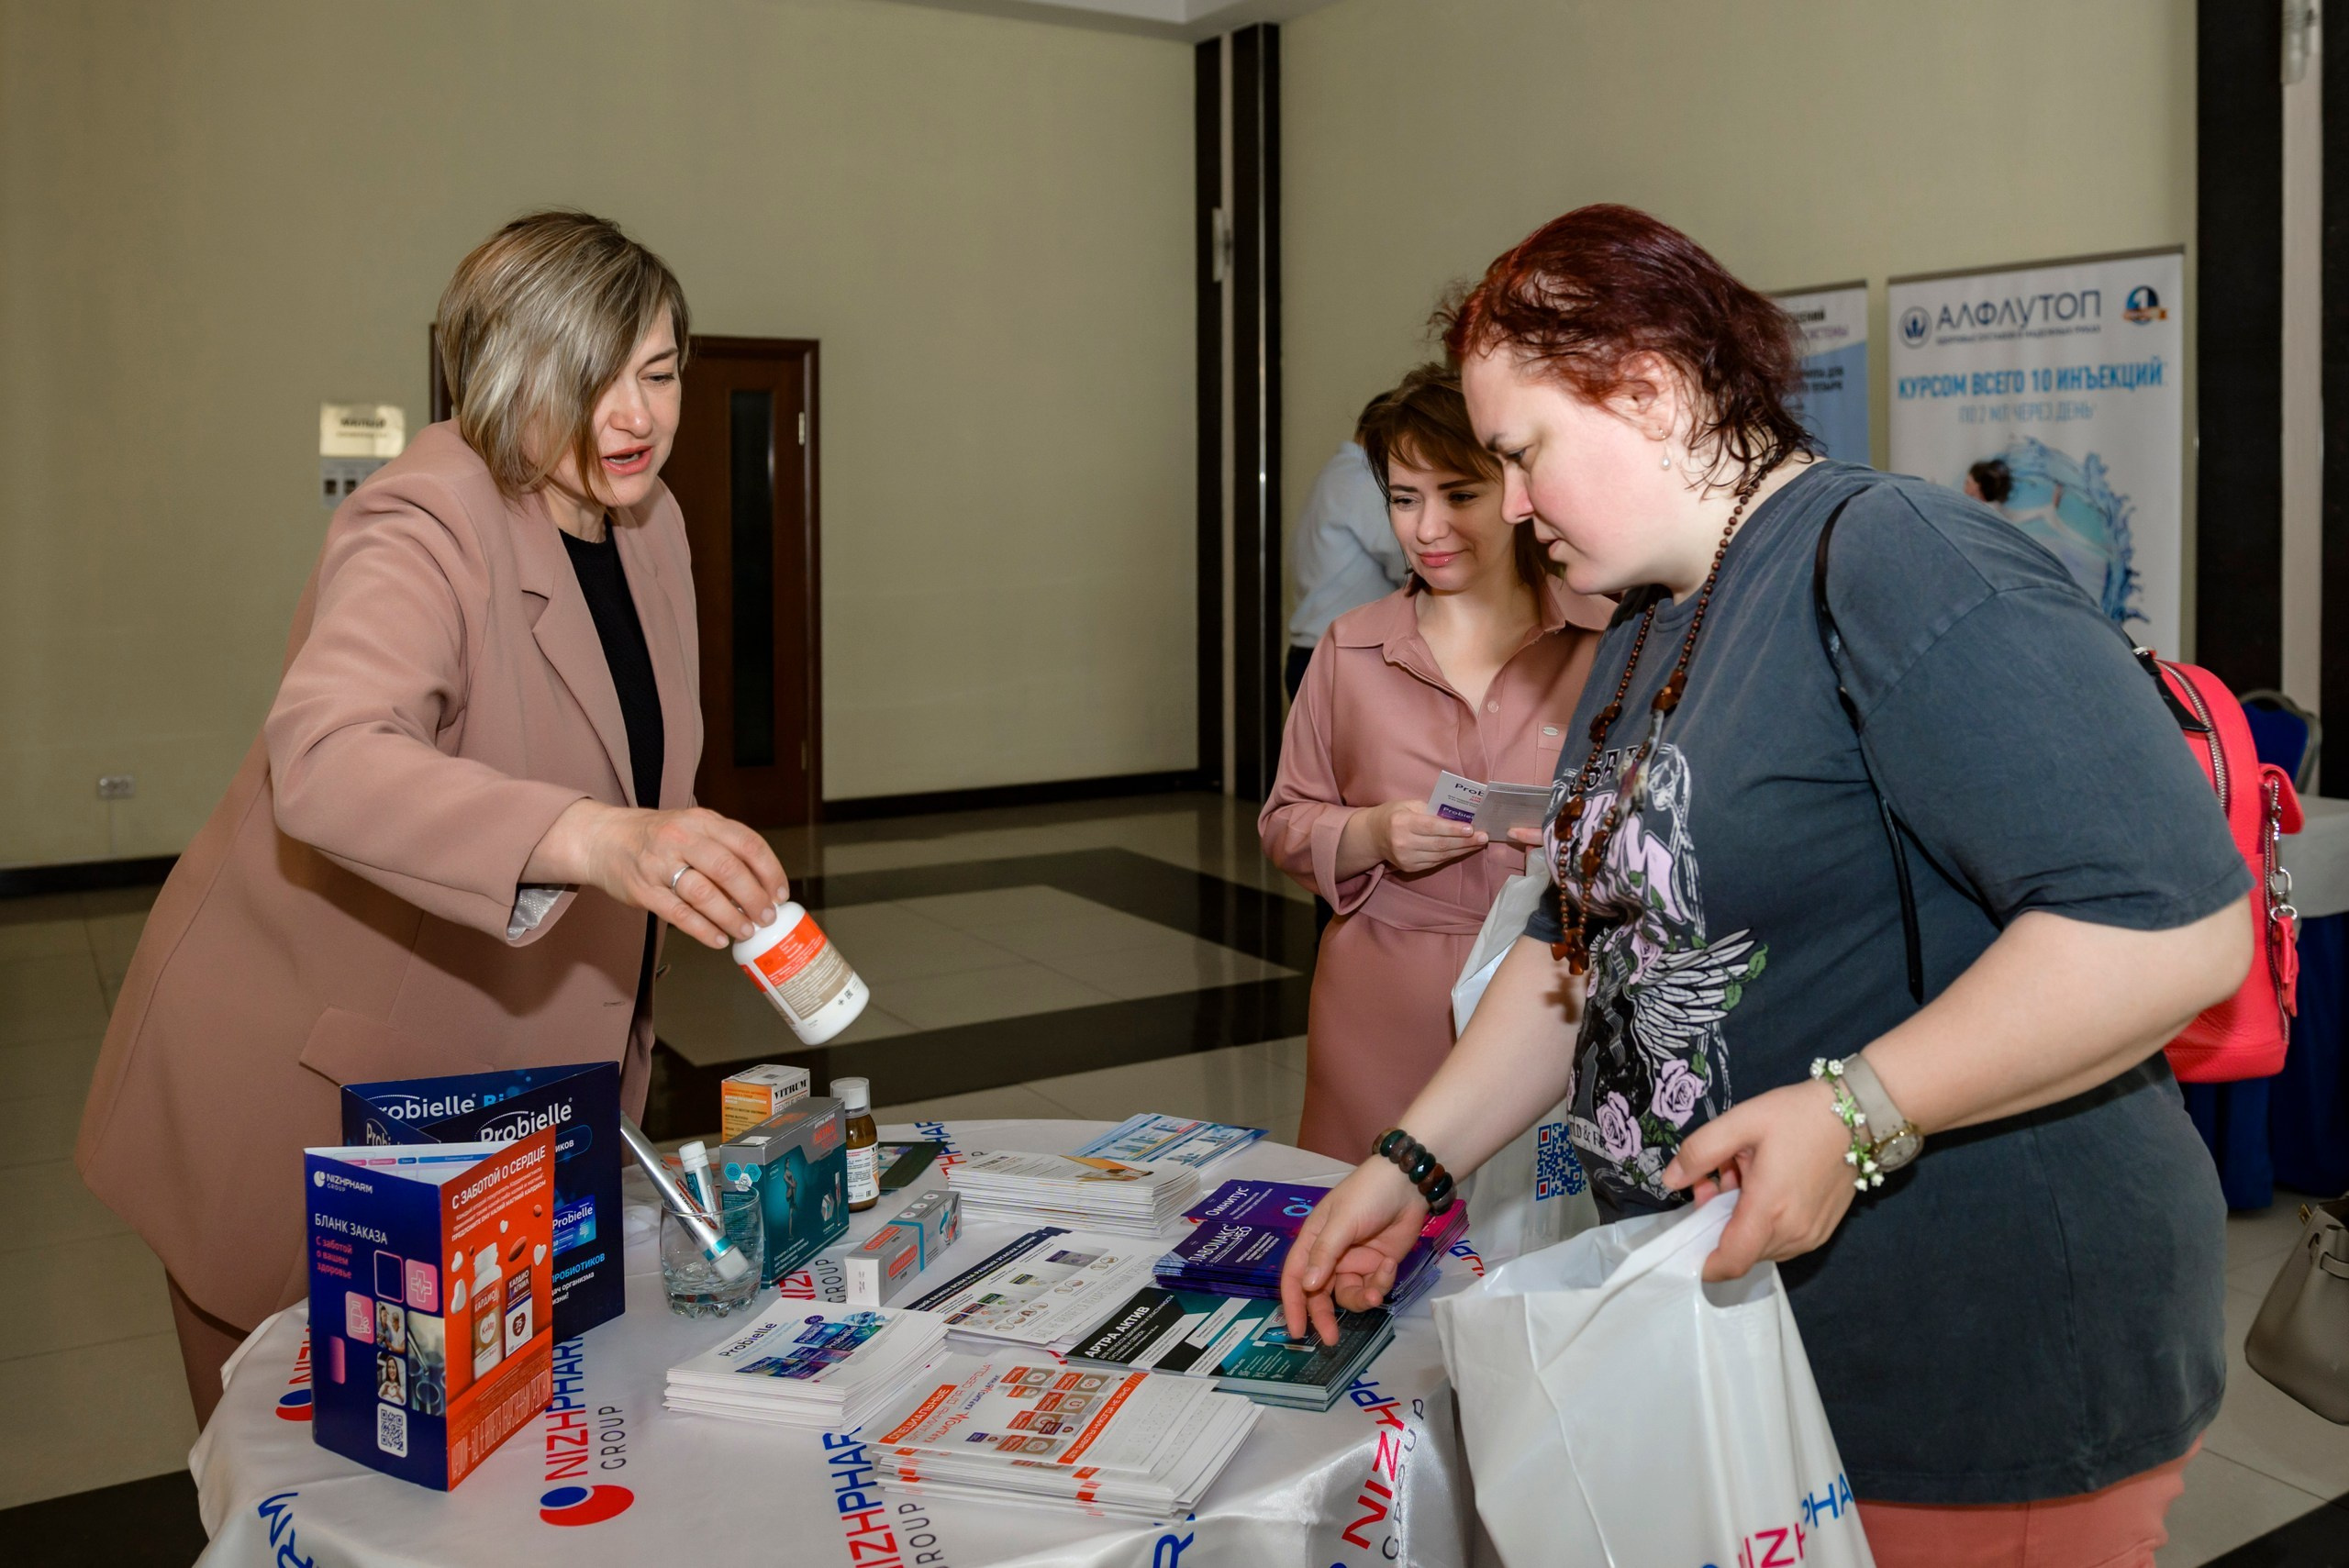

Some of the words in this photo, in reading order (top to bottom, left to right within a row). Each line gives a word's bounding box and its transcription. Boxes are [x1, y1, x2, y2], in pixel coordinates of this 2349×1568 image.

[1936, 289, 2101, 328] АЛФЛУТОП
[1898, 373, 1967, 399] КУРСОМ
[1972, 369, 2025, 395] ВСЕГО
[2032, 367, 2052, 393] 10
[774, 1079, 807, 1099] VITRUM
[479, 1104, 573, 1142] Probielle
[327, 1173, 373, 1194] NIZHPHARM
[327, 1183, 347, 1193] GROUP
[452, 1195, 460, 1209] С
[461, 1166, 500, 1205] ЗАБОТОЙ
[502, 1165, 508, 1179] О
[509, 1145, 546, 1174] СЕРДЦЕ
[315, 1213, 348, 1234] БЛАНК
[350, 1223, 388, 1246] ЗАКАЗА
[316, 1236, 321, 1246] С
[323, 1240, 352, 1255] заботой
[317, 1262, 352, 1279] здоровье
[323, 1251, 349, 1265] вашем
[718, 1322, 777, 1357] Probielle
[1085, 1331, 1121, 1358] АРТРА
[1115, 1306, 1151, 1334] АКТИВ
[545, 1336, 588, 1482] NIZHPHAR
[887, 1388, 951, 1440] СПЕЦИАЛЬНЫЕ
[905, 1407, 950, 1442] ВИТАМИНЫ
[946, 1390, 966, 1405] ДЛЯ
[962, 1364, 993, 1389] СЕРДЦА
[1076, 1428, 1097, 1451] ЗАБОТЫ
[1093, 1405, 1115, 1430] НИКОГДА
[1111, 1396, 1121, 1407] НЕ
[1118, 1385, 1130, 1399] РАНО
[598, 1406, 627, 1471] GROUP
[898, 1503, 945, 1568] ROUP
